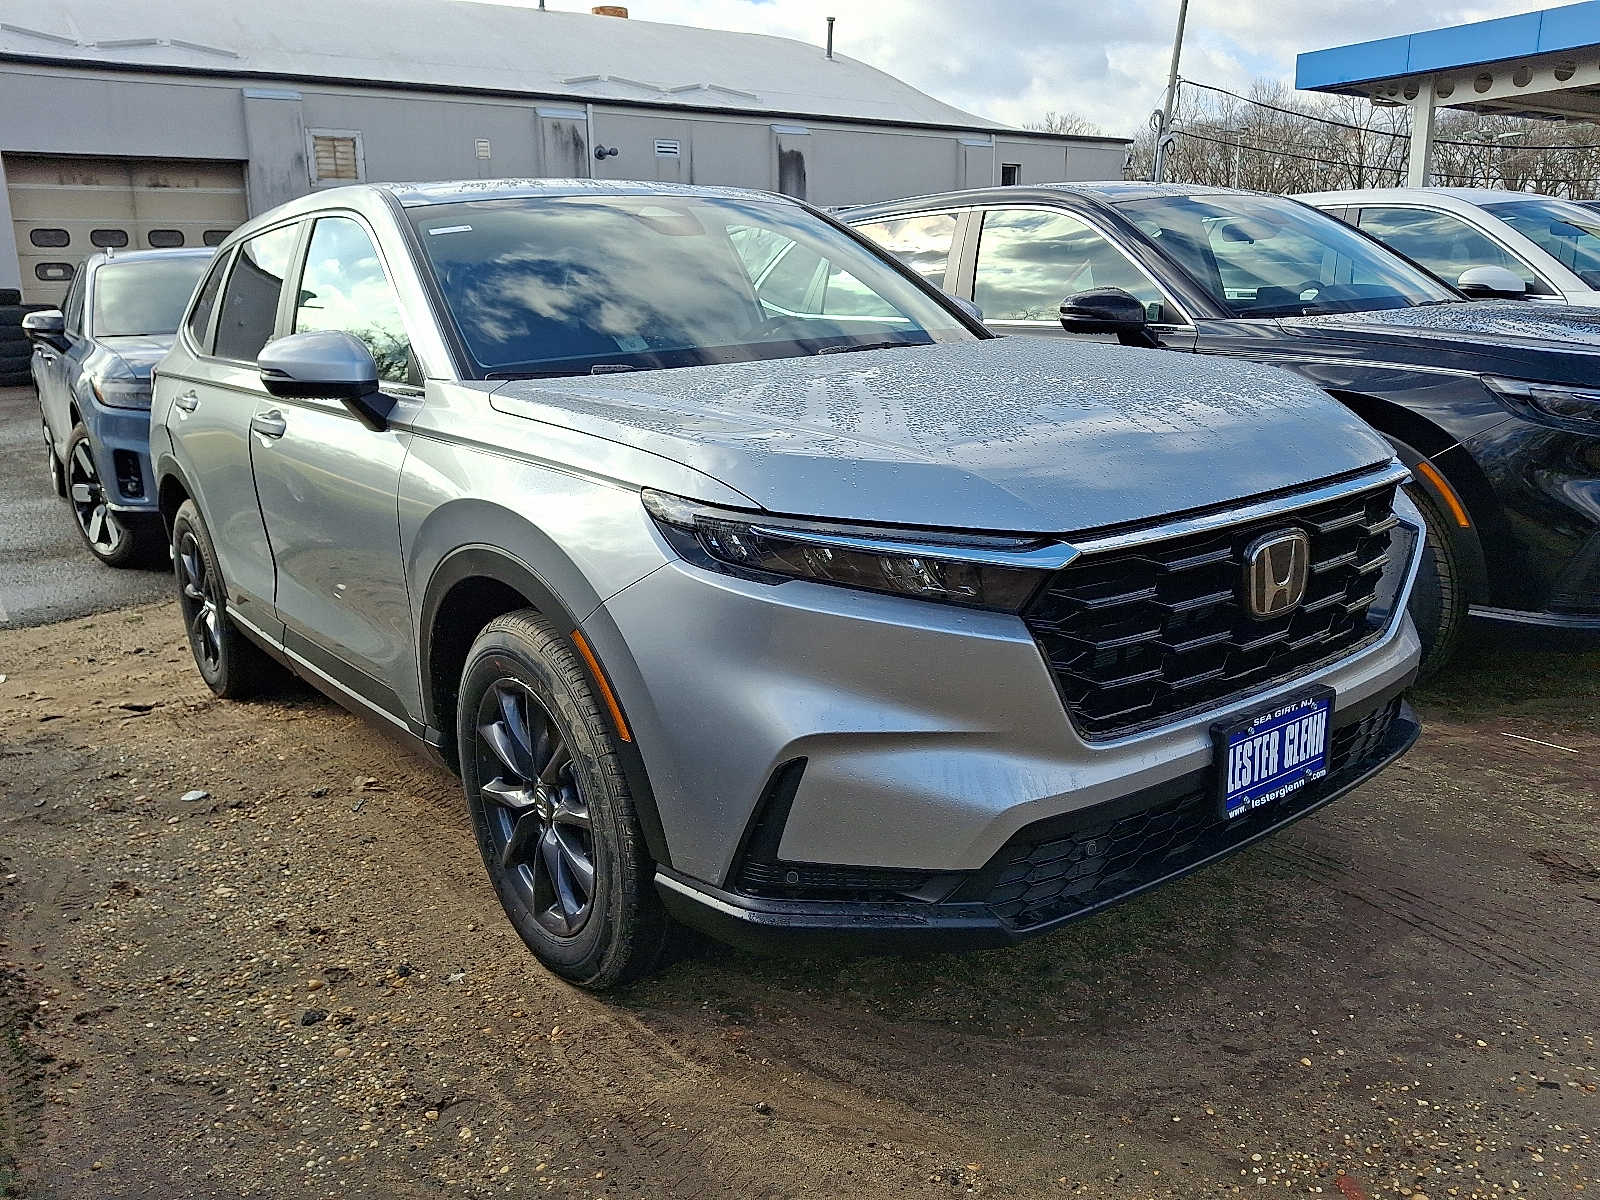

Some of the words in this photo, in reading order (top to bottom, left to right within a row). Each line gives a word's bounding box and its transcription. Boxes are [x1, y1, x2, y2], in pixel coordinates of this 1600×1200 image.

[1253, 713, 1272, 726] SEA
[1300, 697, 1313, 708] NJ
[1227, 730, 1280, 793] LESTER
[1283, 710, 1327, 769] GLENN
